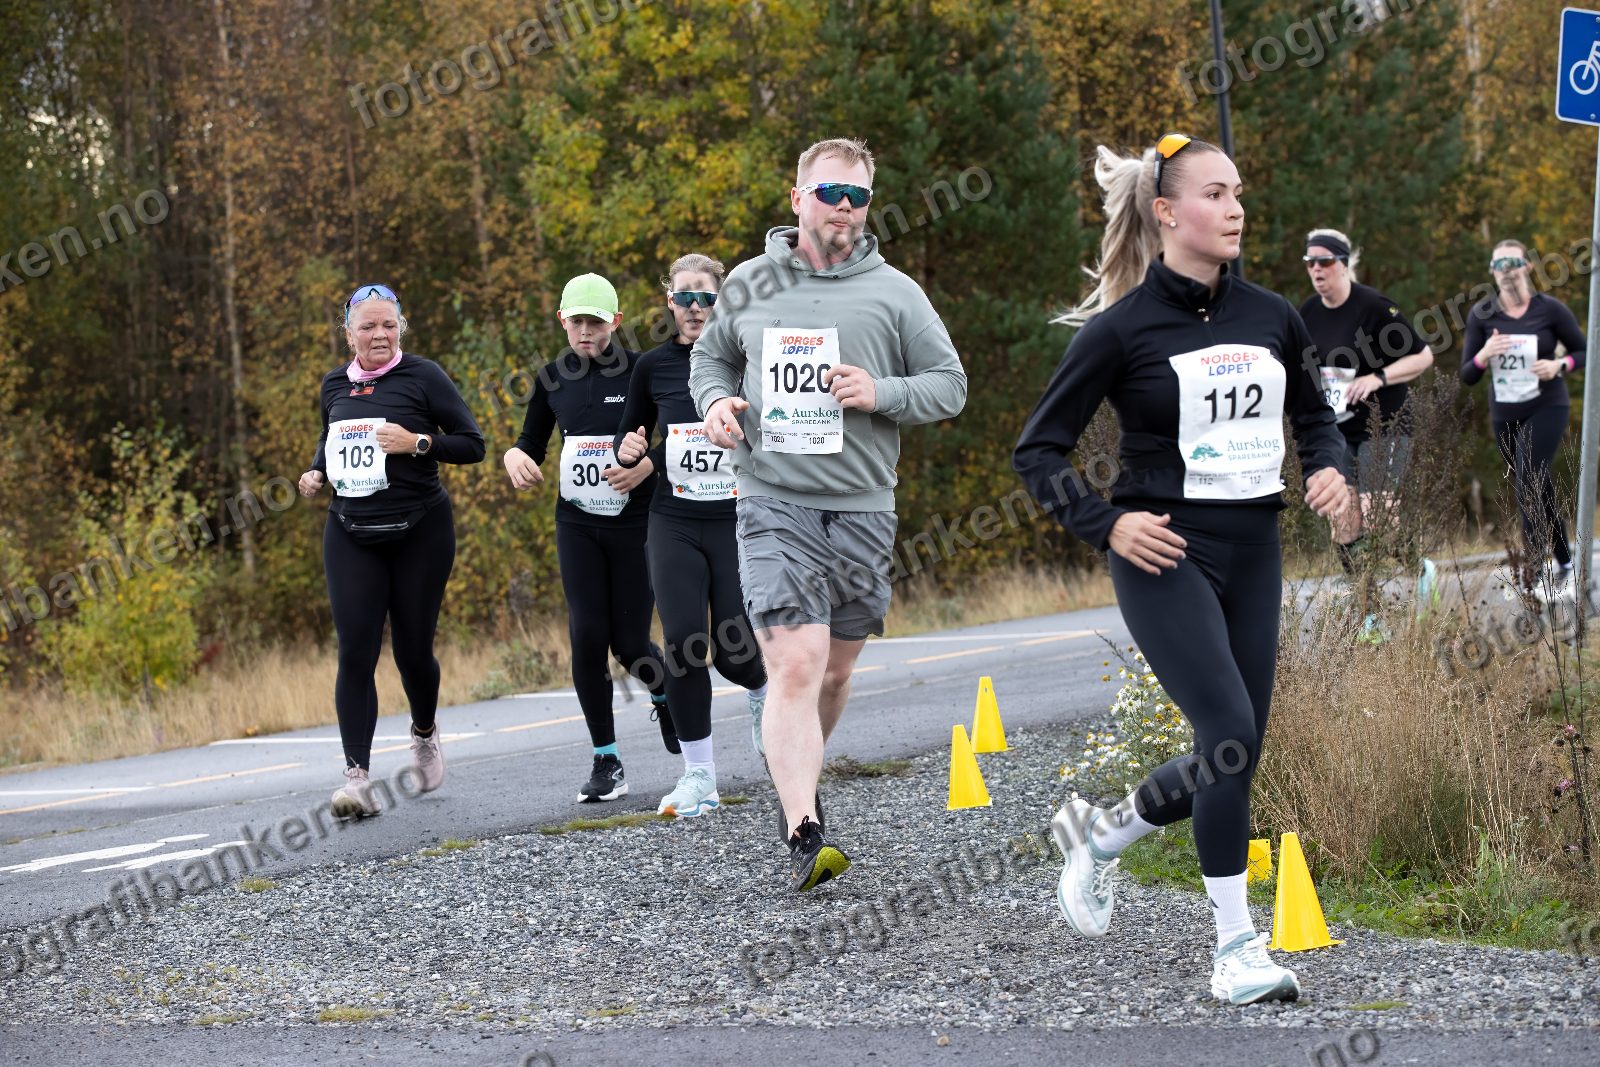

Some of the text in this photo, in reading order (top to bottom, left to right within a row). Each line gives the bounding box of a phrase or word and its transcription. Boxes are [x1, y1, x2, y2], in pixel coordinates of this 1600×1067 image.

[780, 336, 824, 346] NORGES
[782, 345, 816, 355] LØPET
[1201, 352, 1259, 365] NORGES
[1498, 354, 1526, 370] 221
[1208, 362, 1253, 377] LØPET
[769, 362, 834, 394] 1020
[1204, 383, 1263, 424] 112
[791, 407, 840, 420] Aurskog
[338, 424, 374, 434] NORGES
[341, 431, 369, 441] LØPET
[809, 436, 825, 445] 1020
[575, 441, 614, 450] NORGES
[1227, 436, 1281, 453] Aurskog
[338, 445, 375, 469] 103
[576, 449, 608, 457] LØPET
[680, 450, 724, 473] 457
[350, 477, 386, 488] Aurskog
[697, 481, 737, 491] Aurskog
[588, 497, 628, 507] Aurskog
